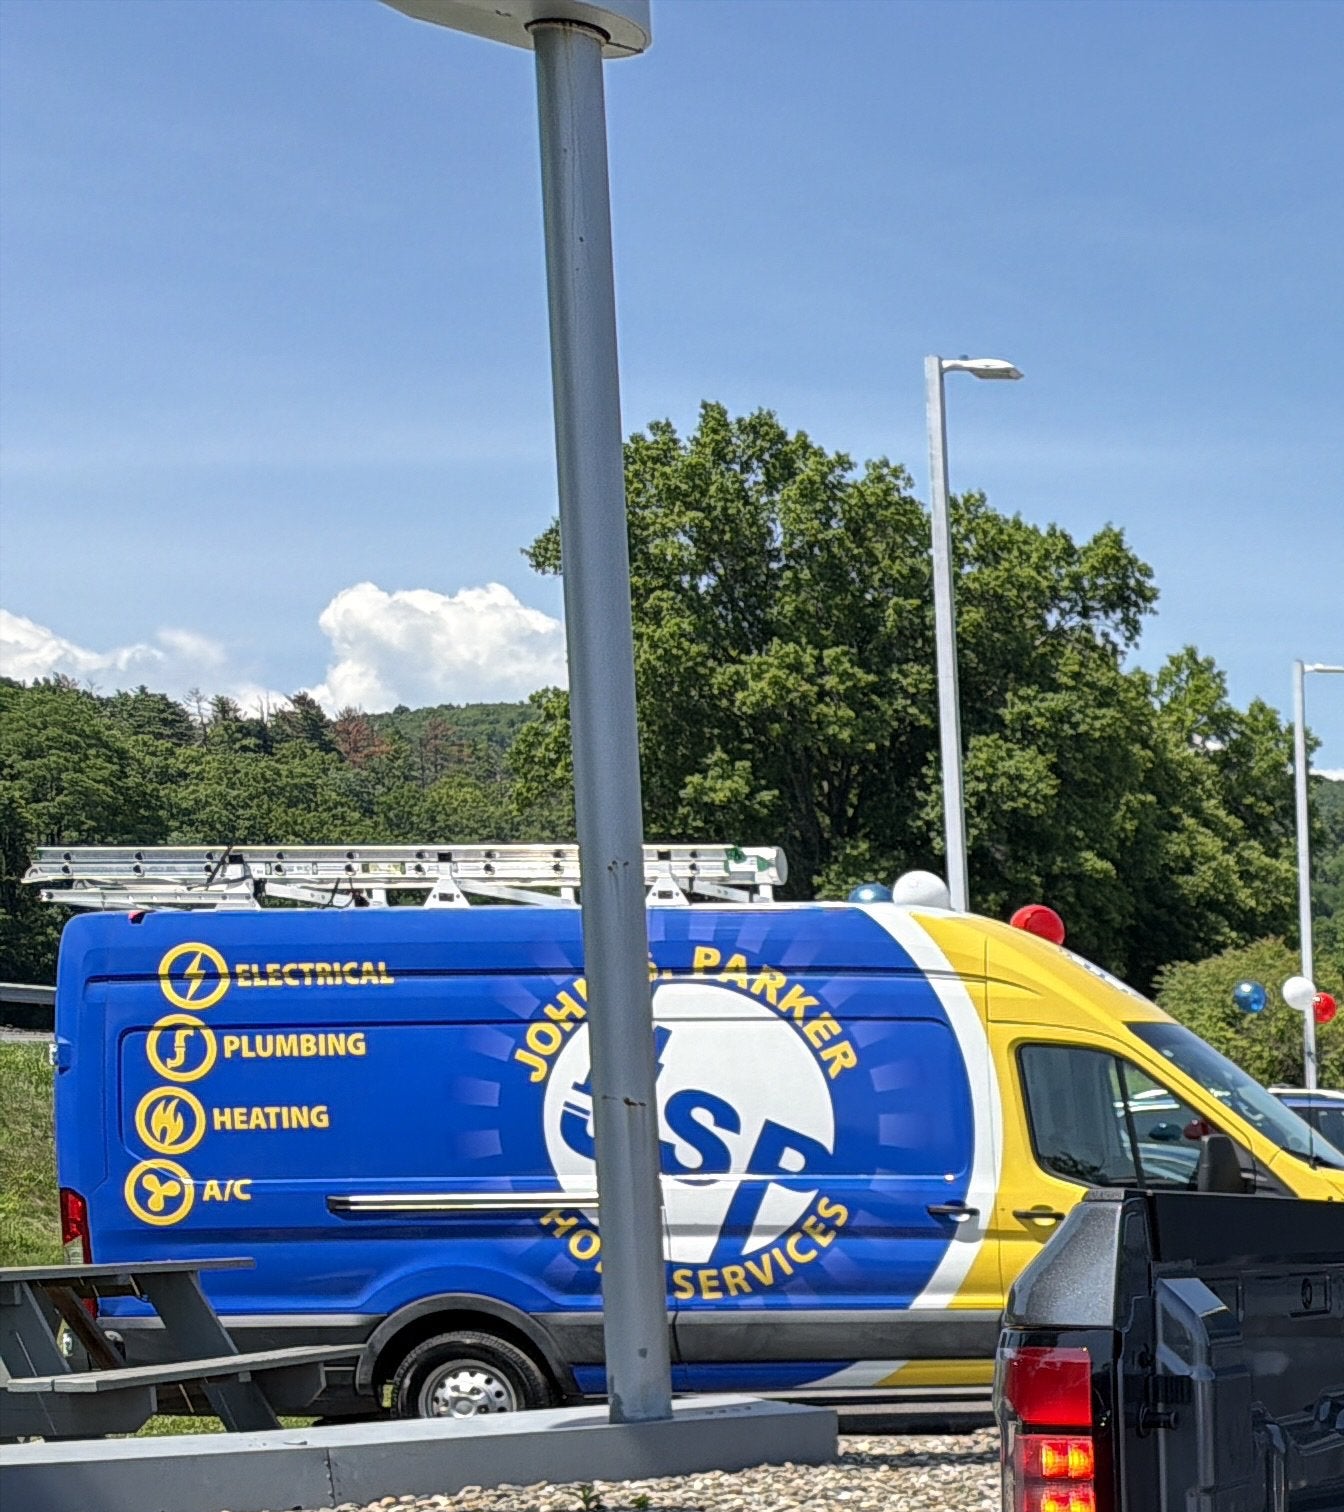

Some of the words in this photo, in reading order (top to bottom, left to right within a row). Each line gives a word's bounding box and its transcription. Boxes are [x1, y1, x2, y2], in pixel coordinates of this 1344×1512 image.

[235, 961, 395, 987] ELECTRICAL
[515, 977, 588, 1083] JOH
[693, 945, 858, 1080] PARKER
[223, 1032, 366, 1059] PLUMBING
[212, 1105, 330, 1131] HEATING
[202, 1179, 253, 1202] A/C
[672, 1196, 849, 1300] SERVICES
